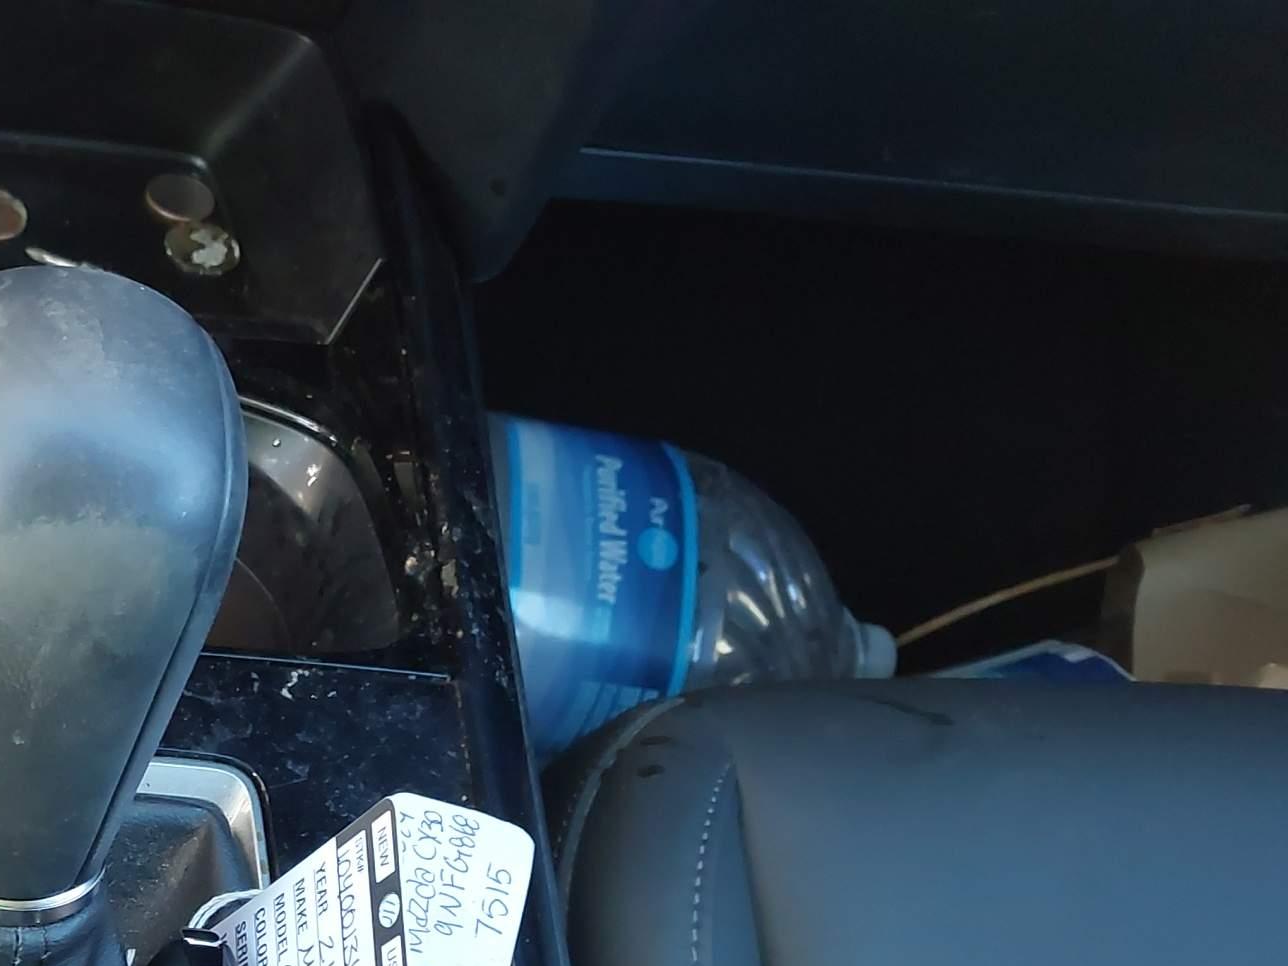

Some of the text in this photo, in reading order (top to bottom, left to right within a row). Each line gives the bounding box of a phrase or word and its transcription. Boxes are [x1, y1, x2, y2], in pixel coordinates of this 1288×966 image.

[595, 454, 628, 604] Purified Water
[376, 825, 391, 868] NEW
[294, 878, 308, 940] MAKE
[313, 861, 330, 917] YEAR
[475, 863, 513, 940] 7515
[274, 892, 289, 965] MODEL
